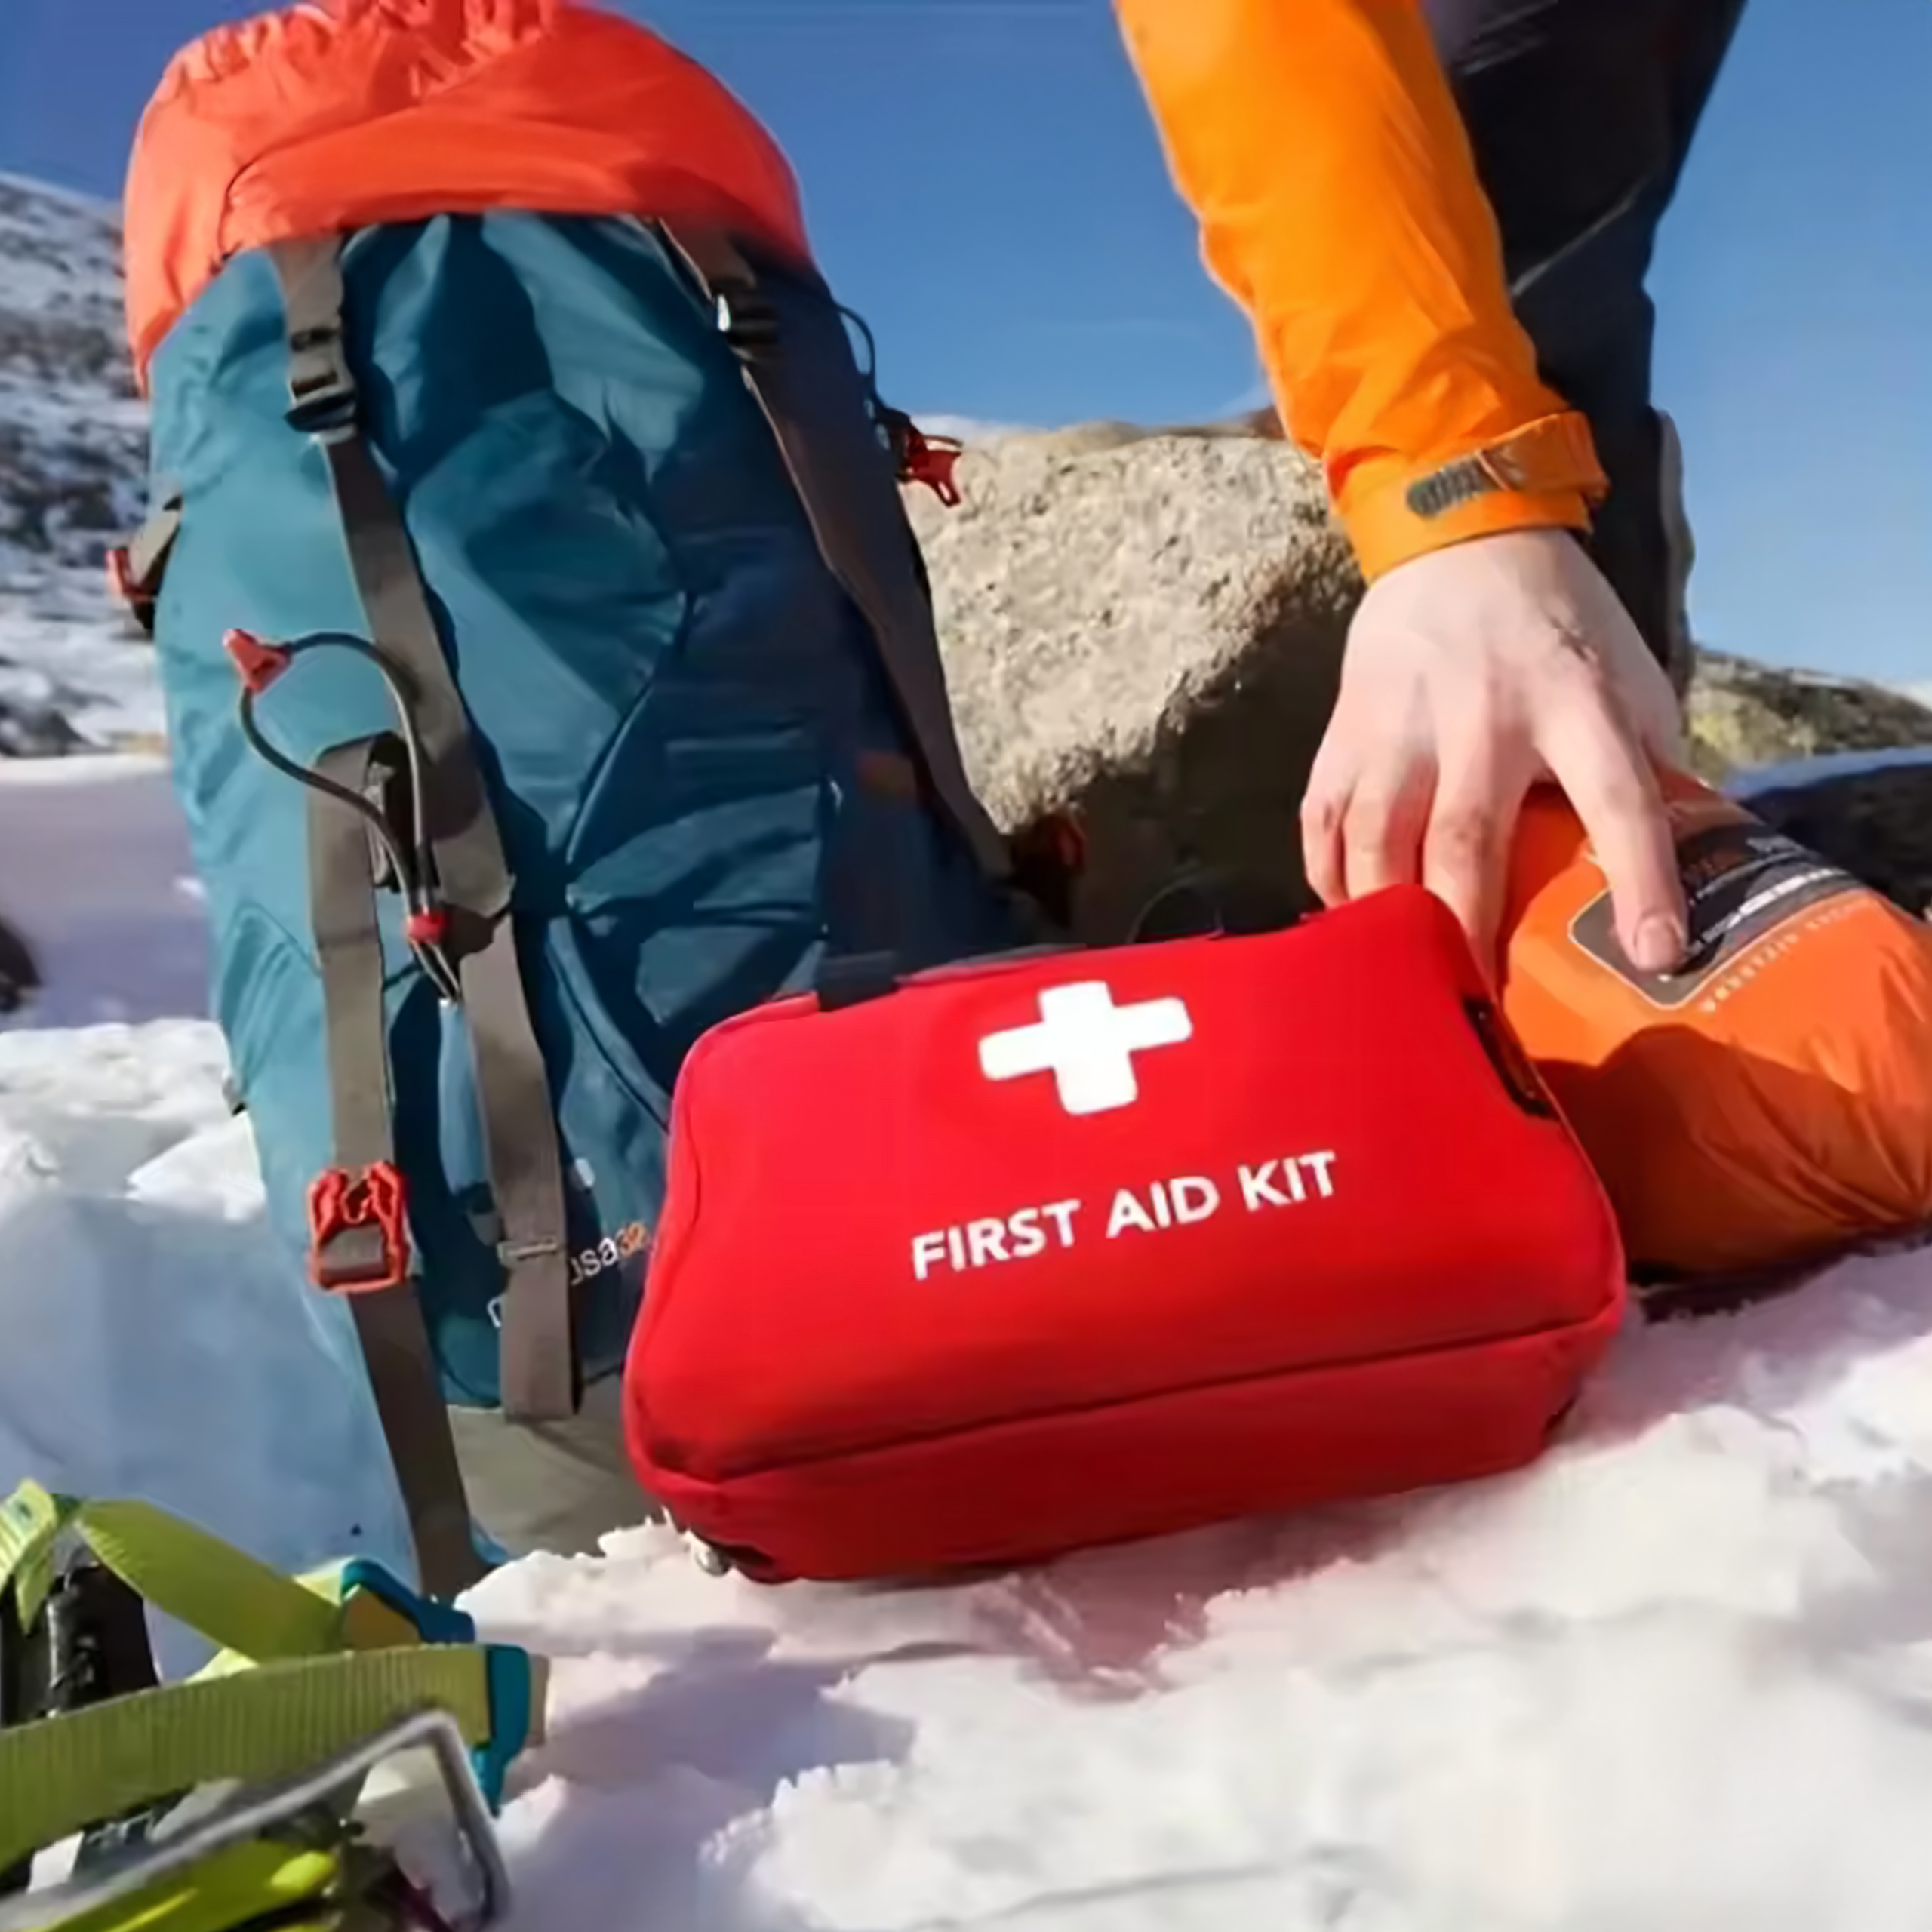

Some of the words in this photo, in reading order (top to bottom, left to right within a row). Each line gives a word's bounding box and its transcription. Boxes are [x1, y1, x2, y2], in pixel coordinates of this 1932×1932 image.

[911, 1198, 1081, 1281] FIRST
[1106, 1176, 1220, 1239] AID
[1237, 1150, 1337, 1212] KIT
